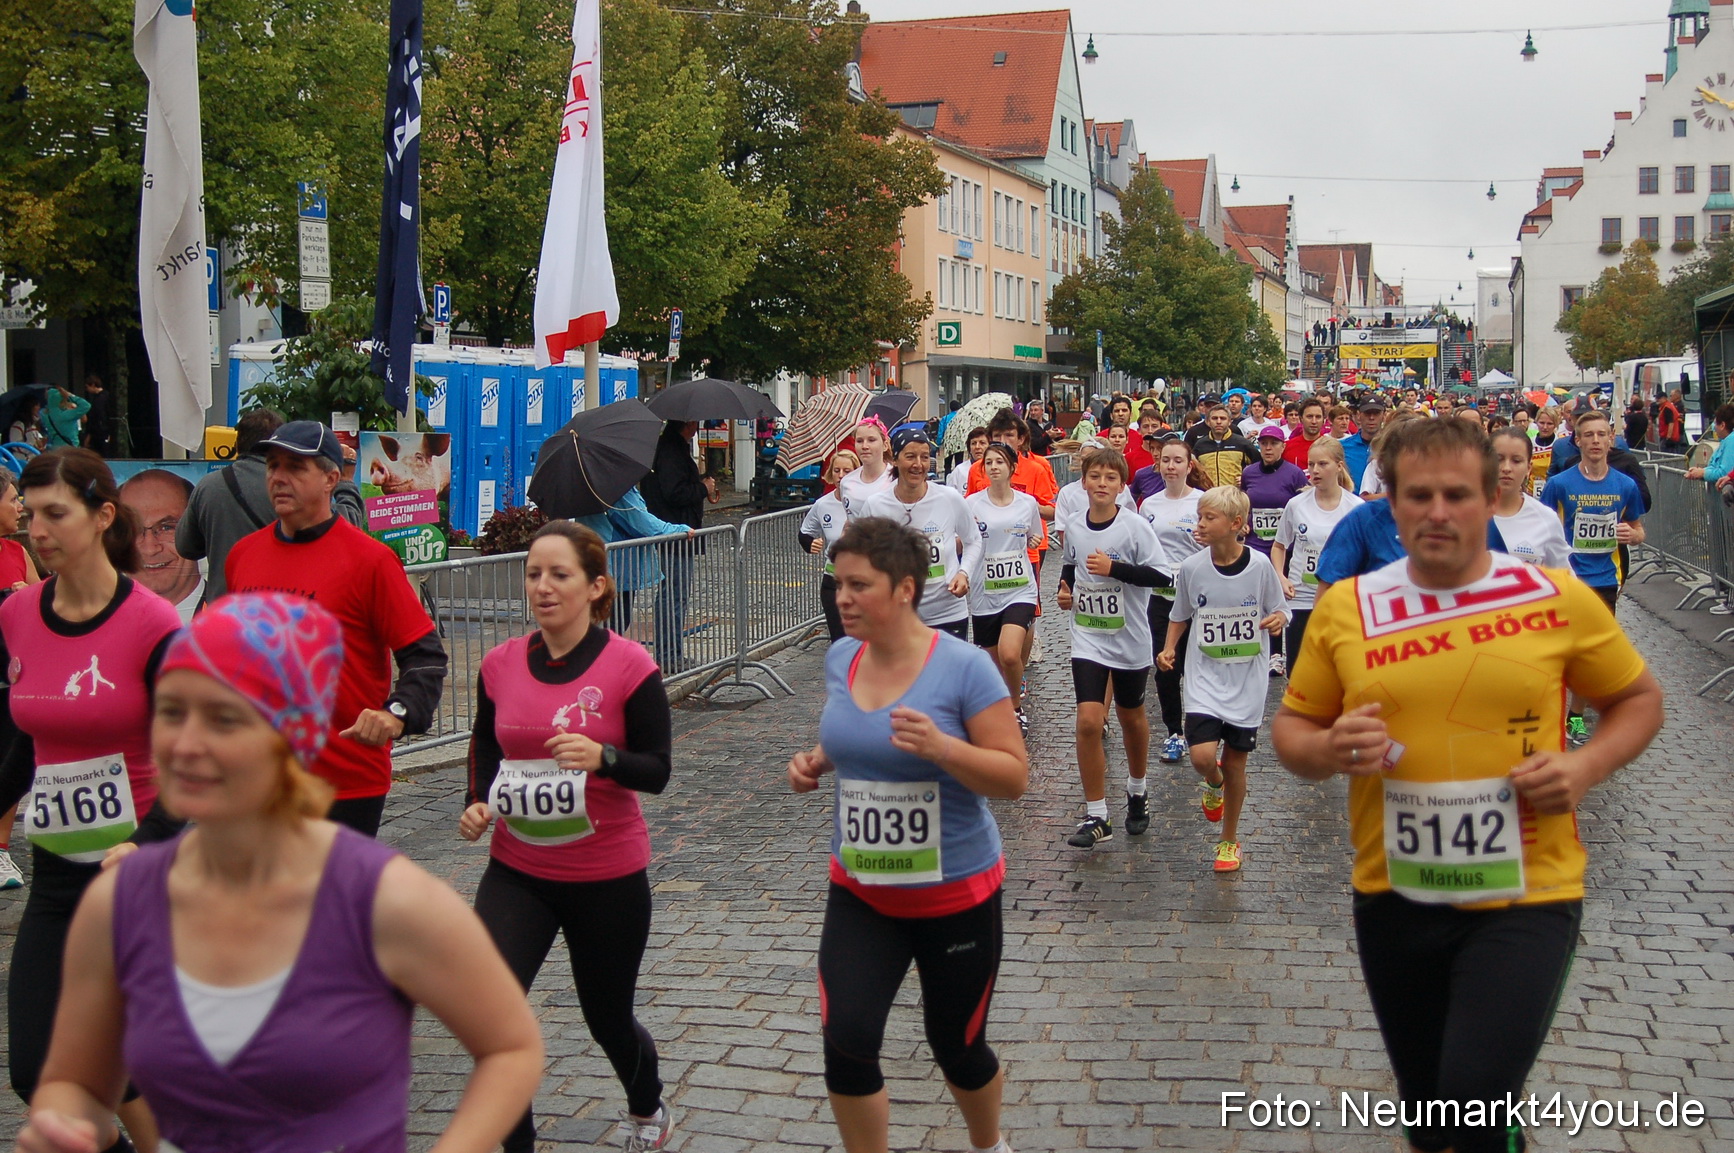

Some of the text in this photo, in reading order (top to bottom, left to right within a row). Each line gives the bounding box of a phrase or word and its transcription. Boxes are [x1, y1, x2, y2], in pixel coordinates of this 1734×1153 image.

[437, 290, 447, 318] P
[673, 315, 680, 337] P
[941, 325, 957, 342] D
[1371, 347, 1404, 356] START
[385, 493, 419, 504] SEPTEMBER
[370, 501, 434, 519] BEIDE STIMMEN
[391, 513, 413, 525] GRÜN
[1579, 523, 1615, 538] 5015
[405, 535, 426, 547] UND
[406, 541, 444, 564] DU?
[986, 560, 1024, 579] 5078
[994, 581, 1019, 589] Ramona
[1078, 593, 1119, 614] 5118
[1219, 612, 1249, 620] Neumarkt
[1203, 620, 1255, 643] 5143
[1365, 611, 1569, 670] MAX BÖGL
[1221, 648, 1238, 656] Max
[52, 769, 105, 785] Neumarkt
[521, 768, 568, 779] Neumarkt
[497, 780, 575, 816] 5169
[841, 789, 918, 803] PARTL Neumarkt
[1385, 791, 1492, 807] PARTL Neumarkt
[32, 781, 123, 830] 5168
[847, 805, 929, 846] 5039
[1396, 809, 1507, 857] 5142
[855, 854, 913, 870] Gordana
[1420, 868, 1485, 887] Markus
